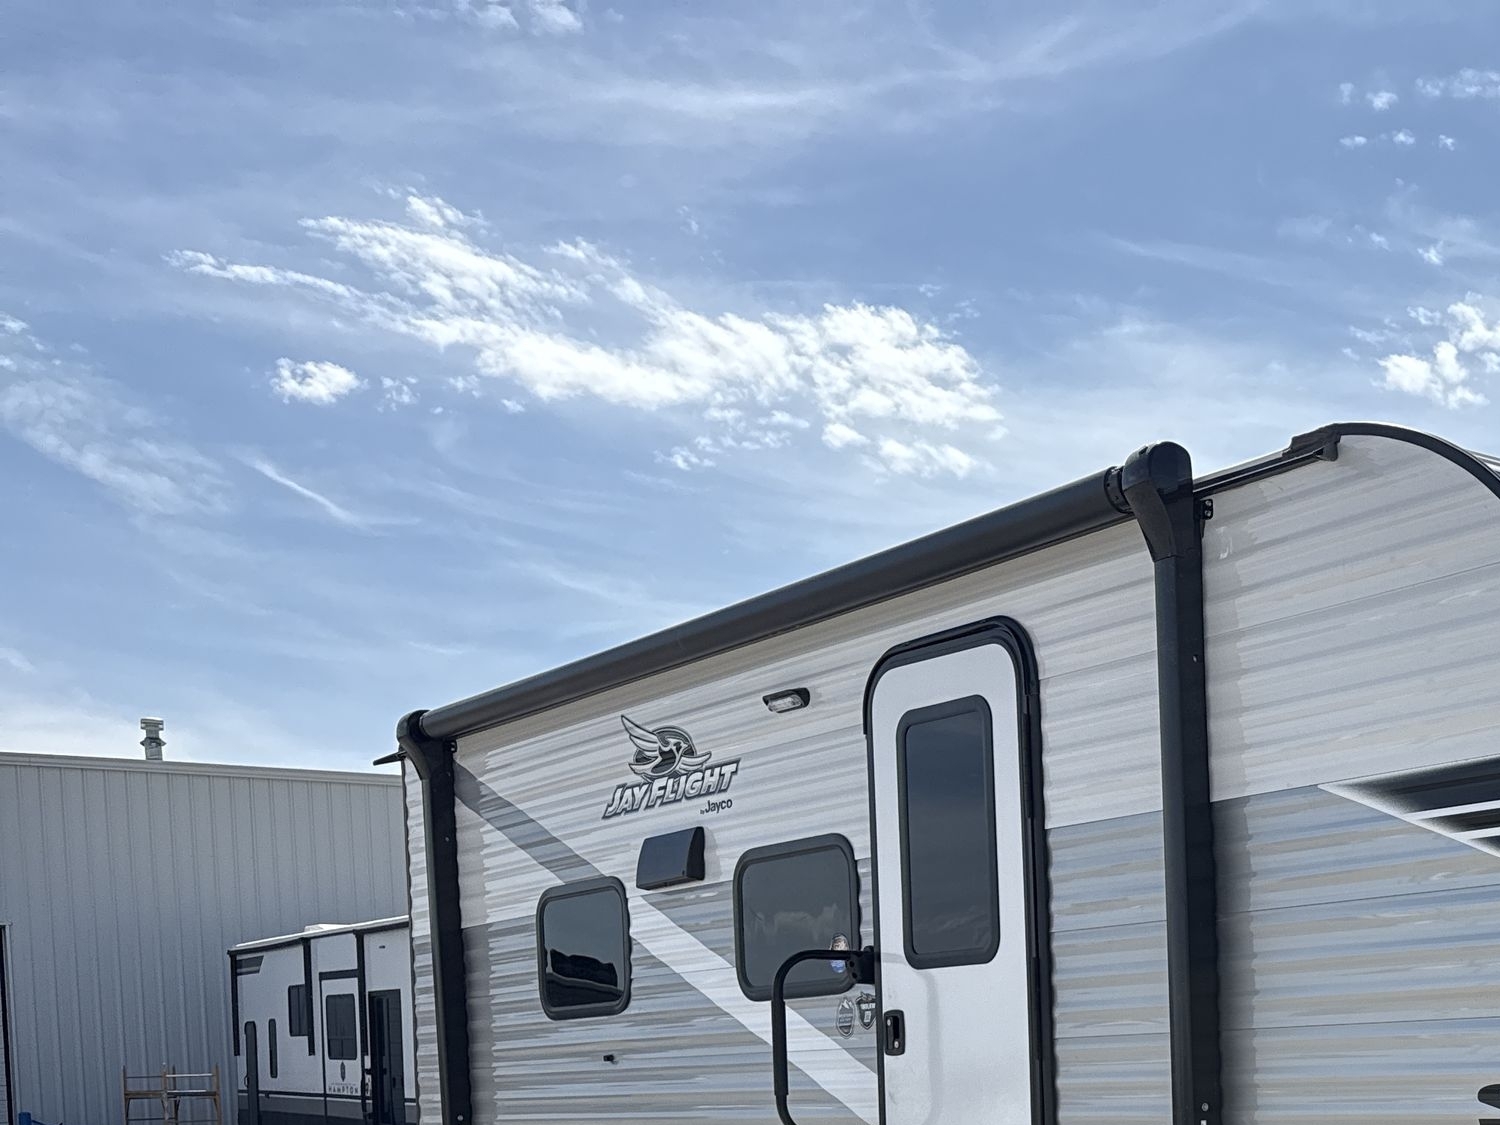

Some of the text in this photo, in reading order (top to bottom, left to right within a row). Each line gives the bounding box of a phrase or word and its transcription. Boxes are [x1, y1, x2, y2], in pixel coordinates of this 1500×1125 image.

[602, 758, 741, 819] JAY FLIGHT
[705, 799, 733, 814] Jayco
